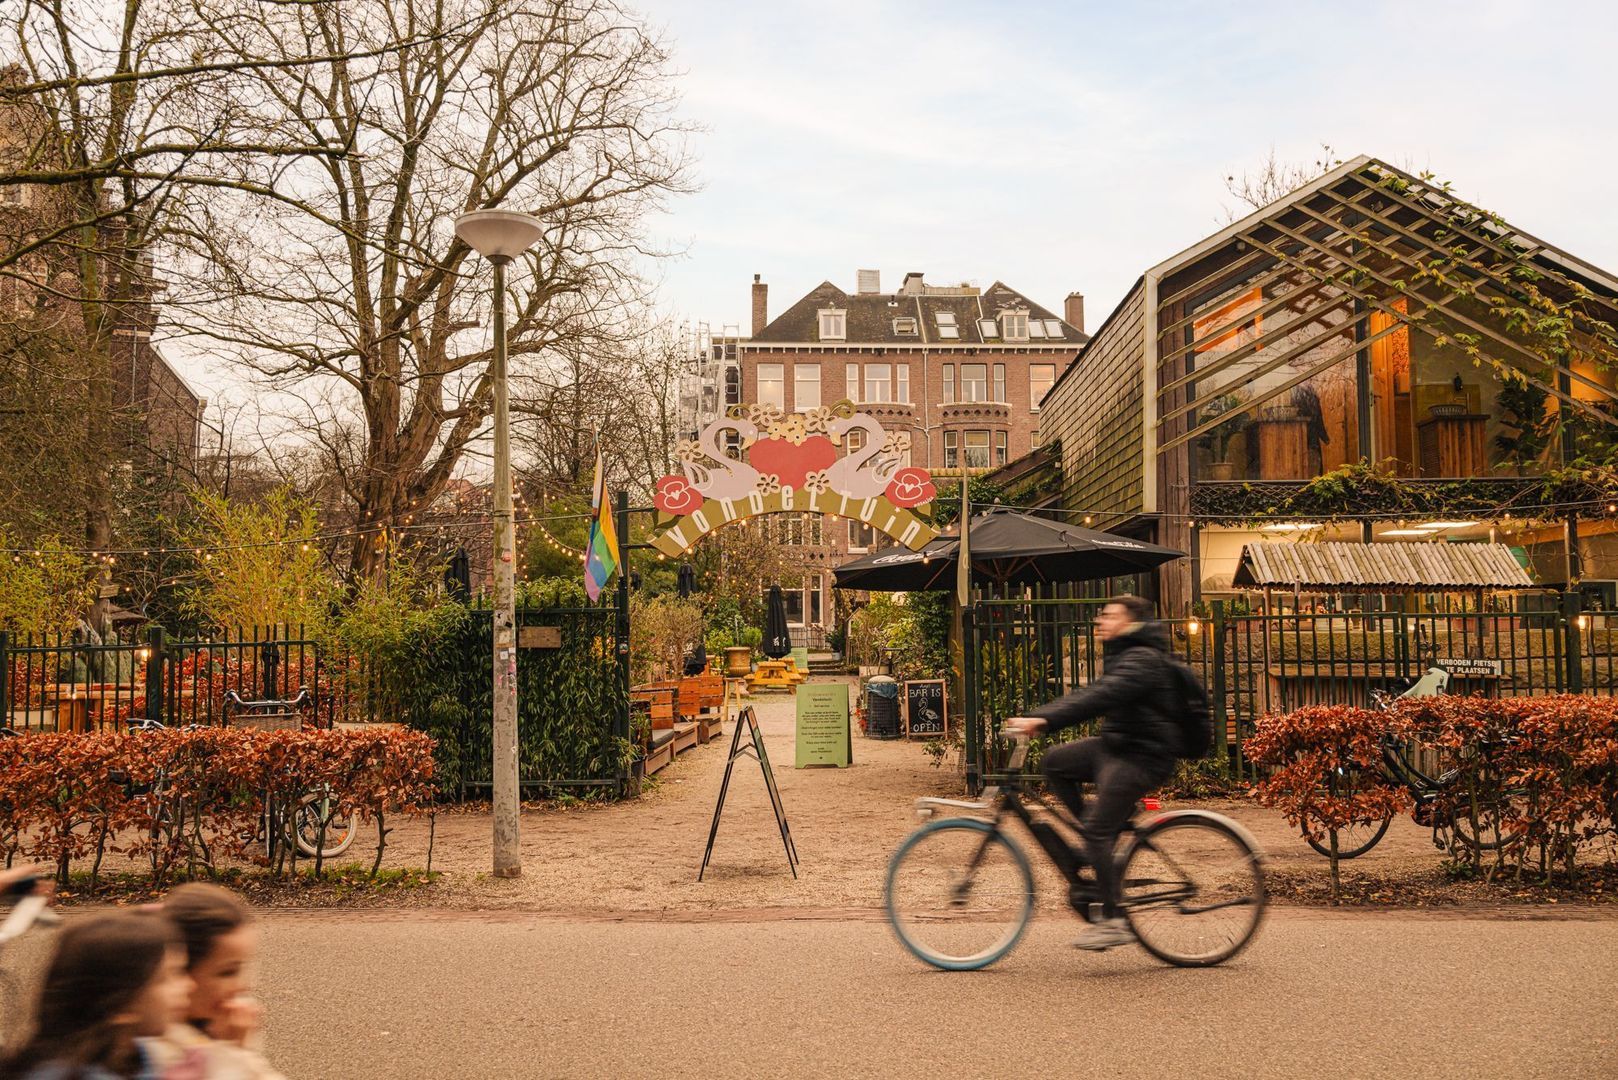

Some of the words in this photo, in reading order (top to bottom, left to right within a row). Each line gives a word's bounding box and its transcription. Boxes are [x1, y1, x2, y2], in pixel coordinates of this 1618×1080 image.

[909, 689, 928, 698] BAR
[931, 688, 941, 698] IS
[913, 723, 940, 732] OPEN
